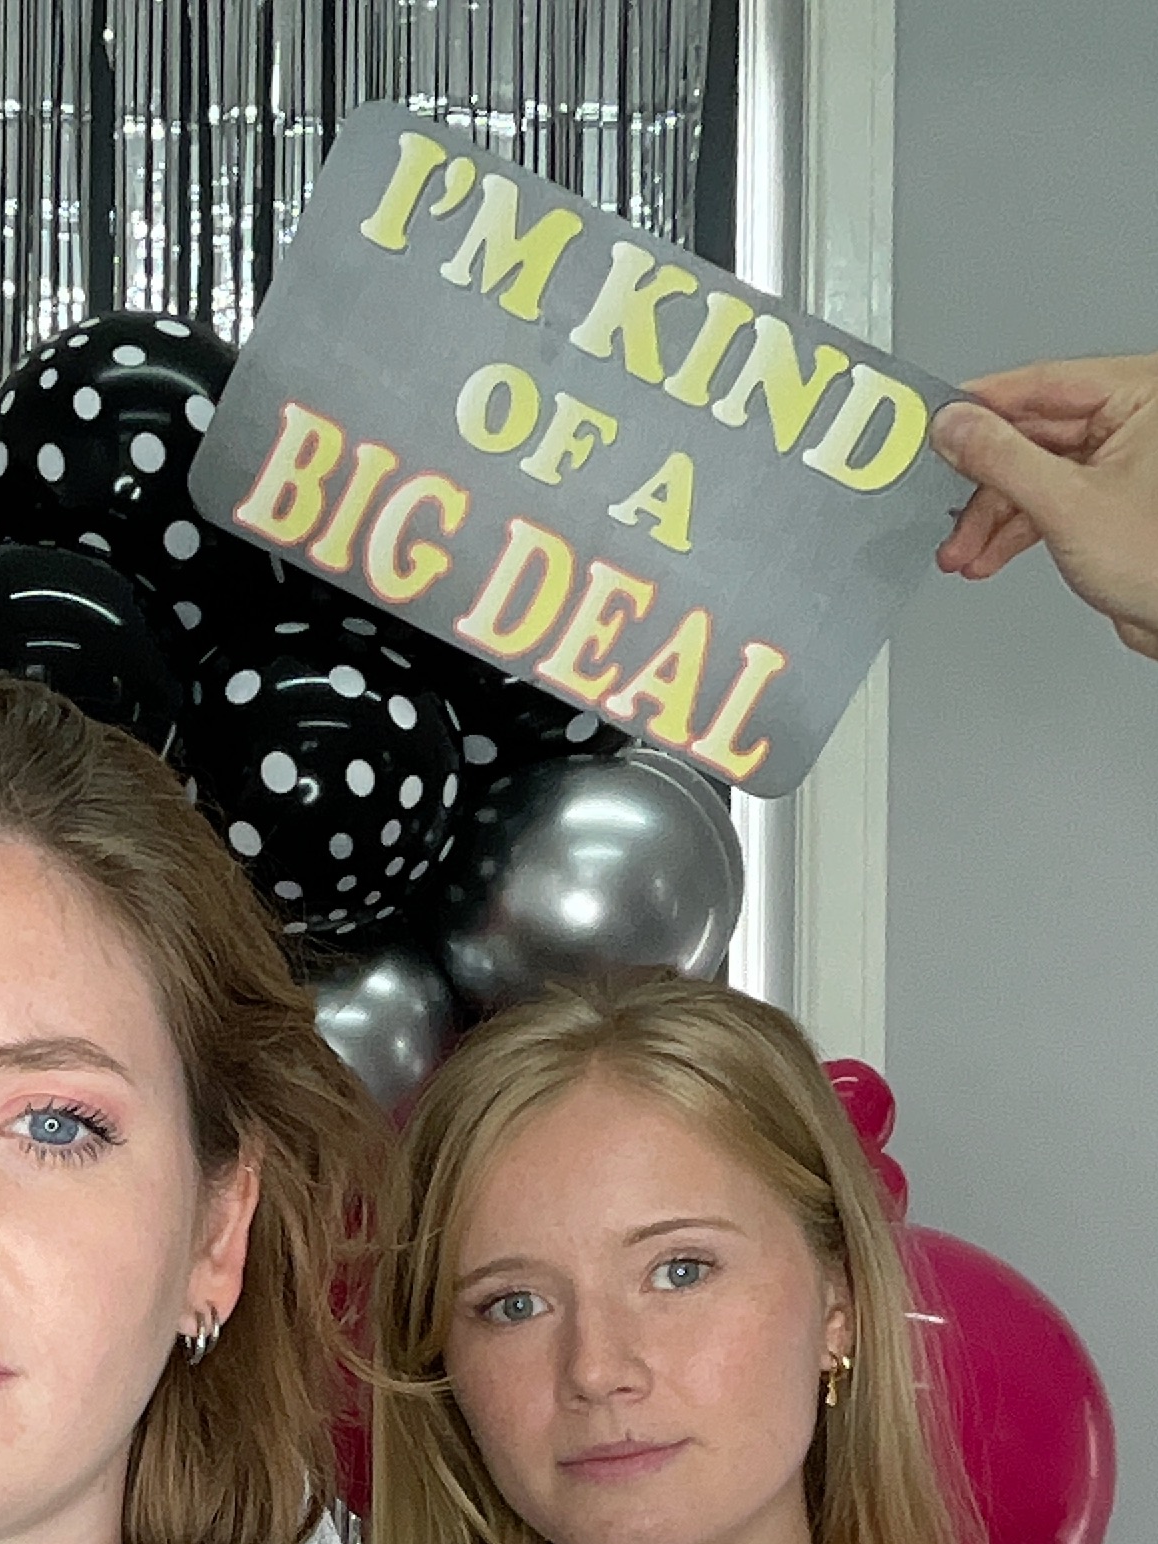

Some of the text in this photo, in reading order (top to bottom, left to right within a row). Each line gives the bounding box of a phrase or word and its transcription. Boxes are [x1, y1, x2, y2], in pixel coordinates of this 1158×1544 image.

[360, 131, 928, 492] I'M KIND
[455, 363, 693, 552] OF A
[235, 401, 787, 782] BIG DEAL
